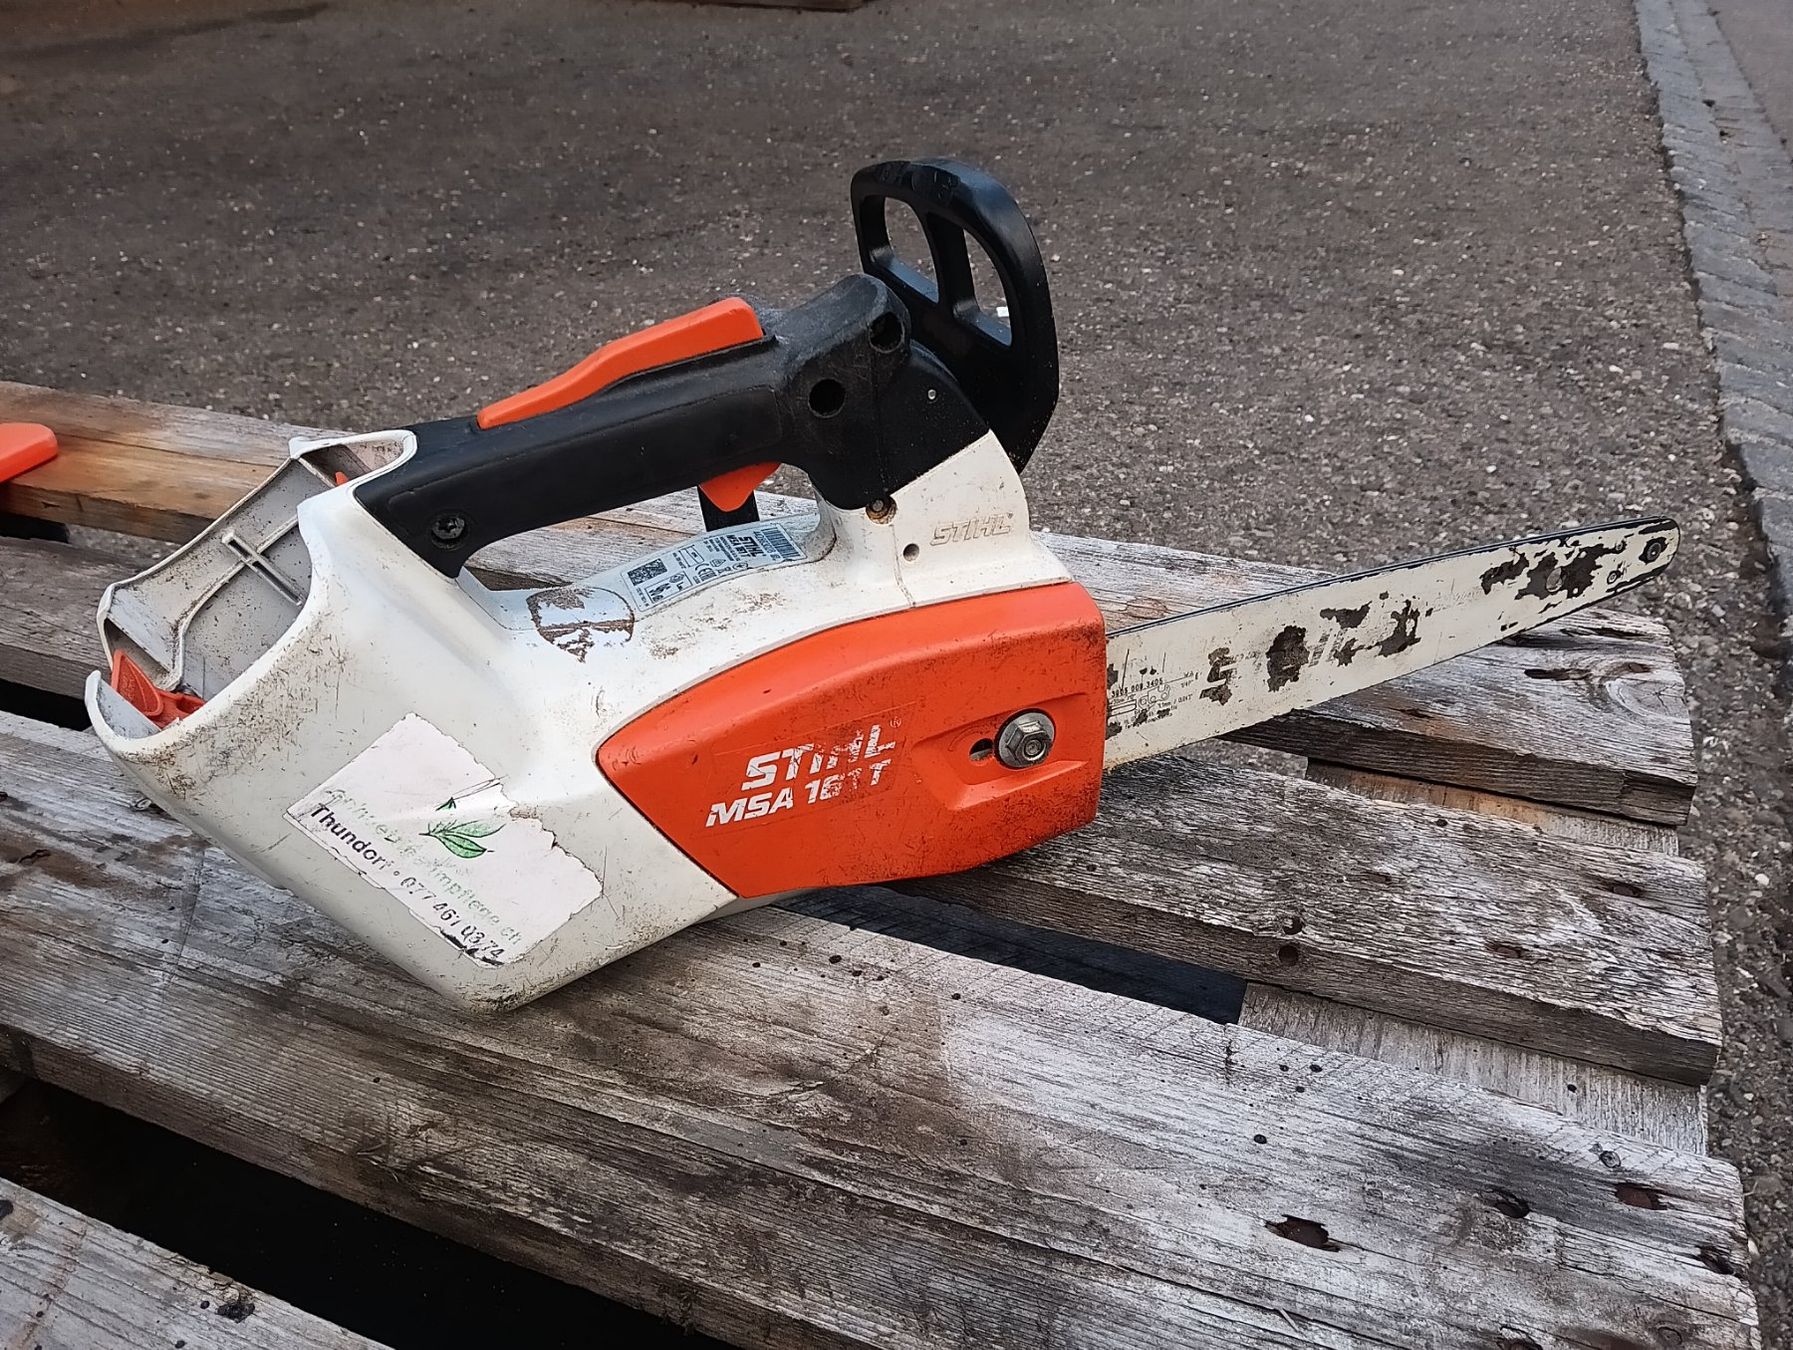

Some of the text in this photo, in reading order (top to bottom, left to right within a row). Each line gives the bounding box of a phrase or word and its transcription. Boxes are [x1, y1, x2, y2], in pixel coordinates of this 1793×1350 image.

[741, 724, 896, 791] STIHL
[705, 787, 794, 827] MSA
[869, 758, 892, 786] T
